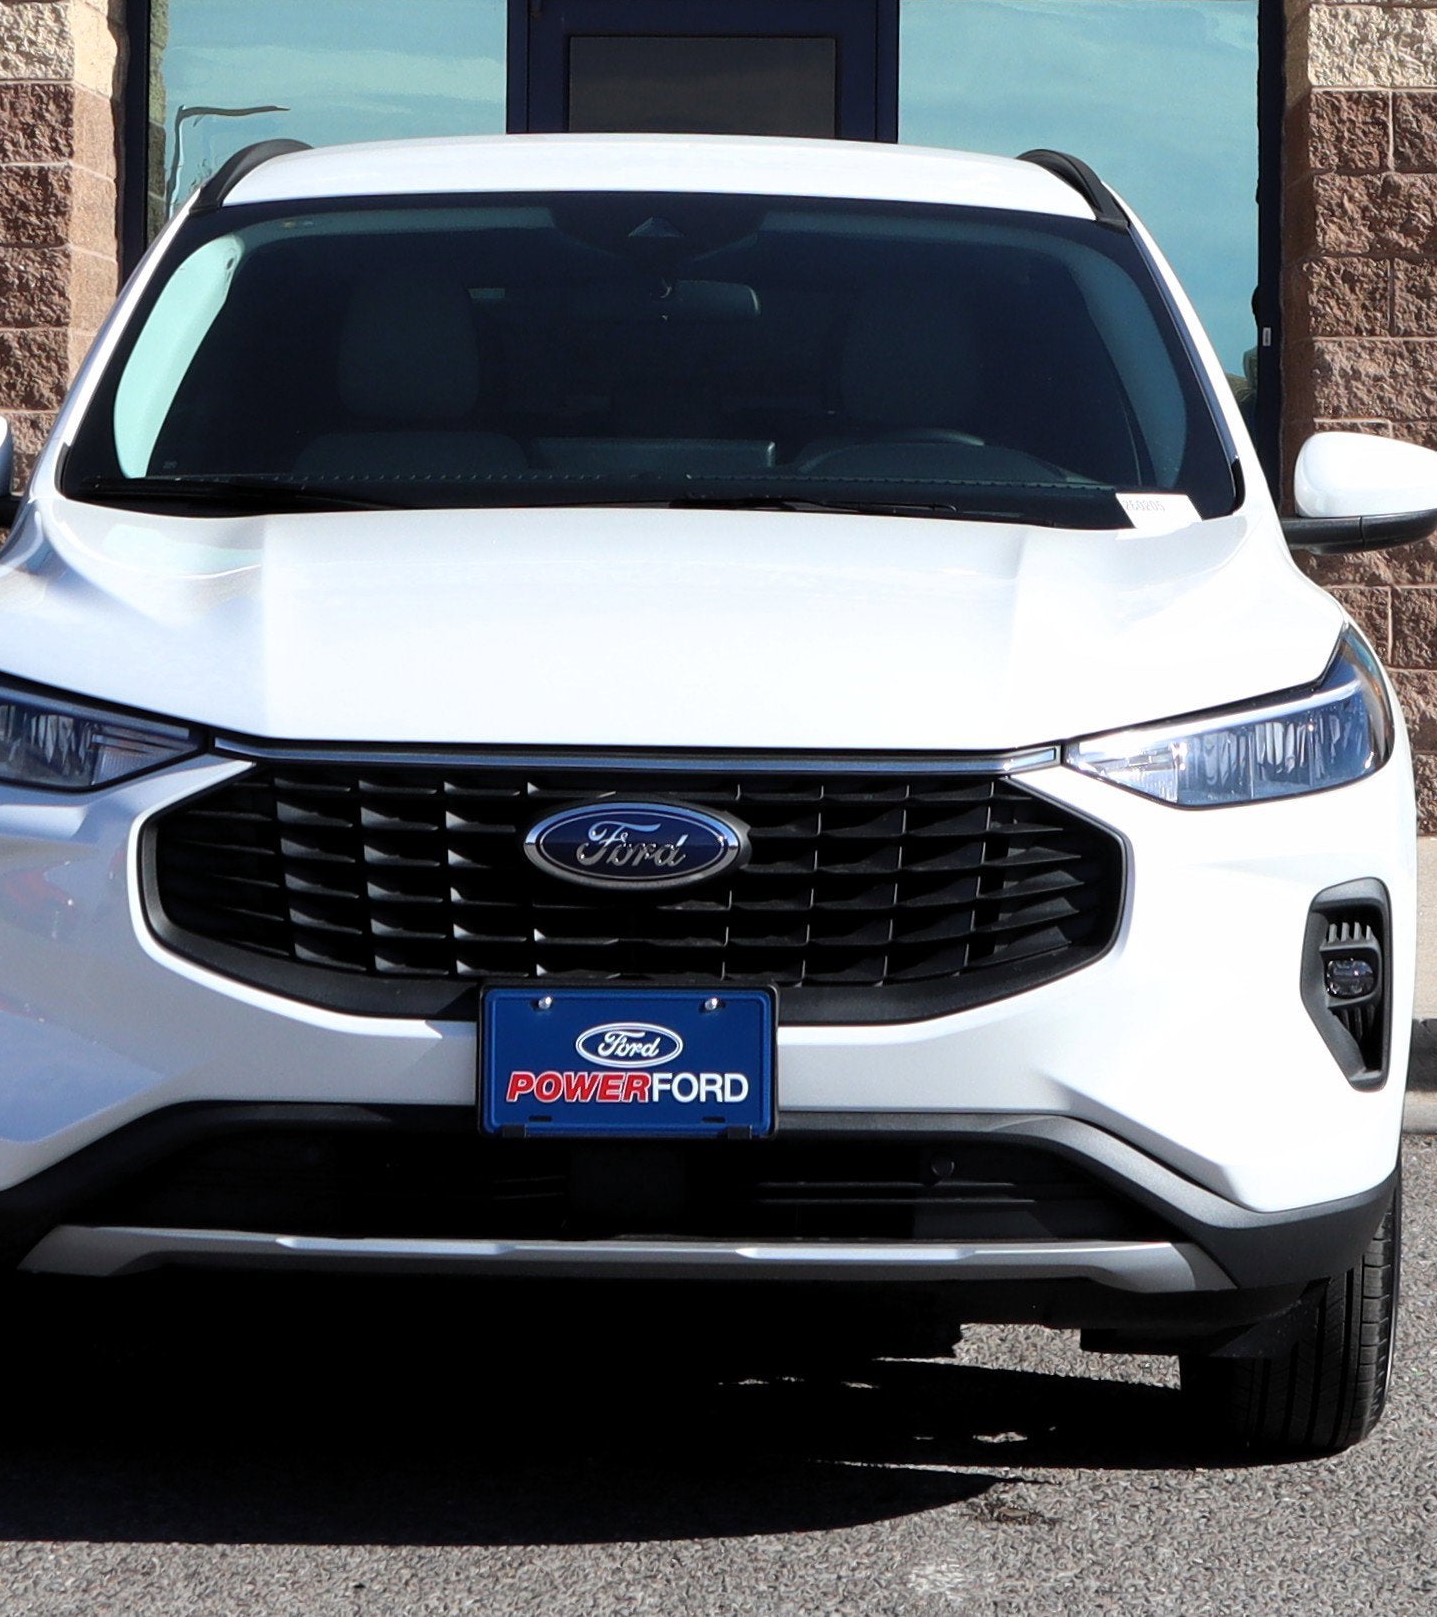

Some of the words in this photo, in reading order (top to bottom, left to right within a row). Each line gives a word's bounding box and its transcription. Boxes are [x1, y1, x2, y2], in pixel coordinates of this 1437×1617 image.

[576, 820, 689, 867] Ford
[597, 1031, 660, 1058] Ford
[506, 1071, 749, 1103] POWERFORD
